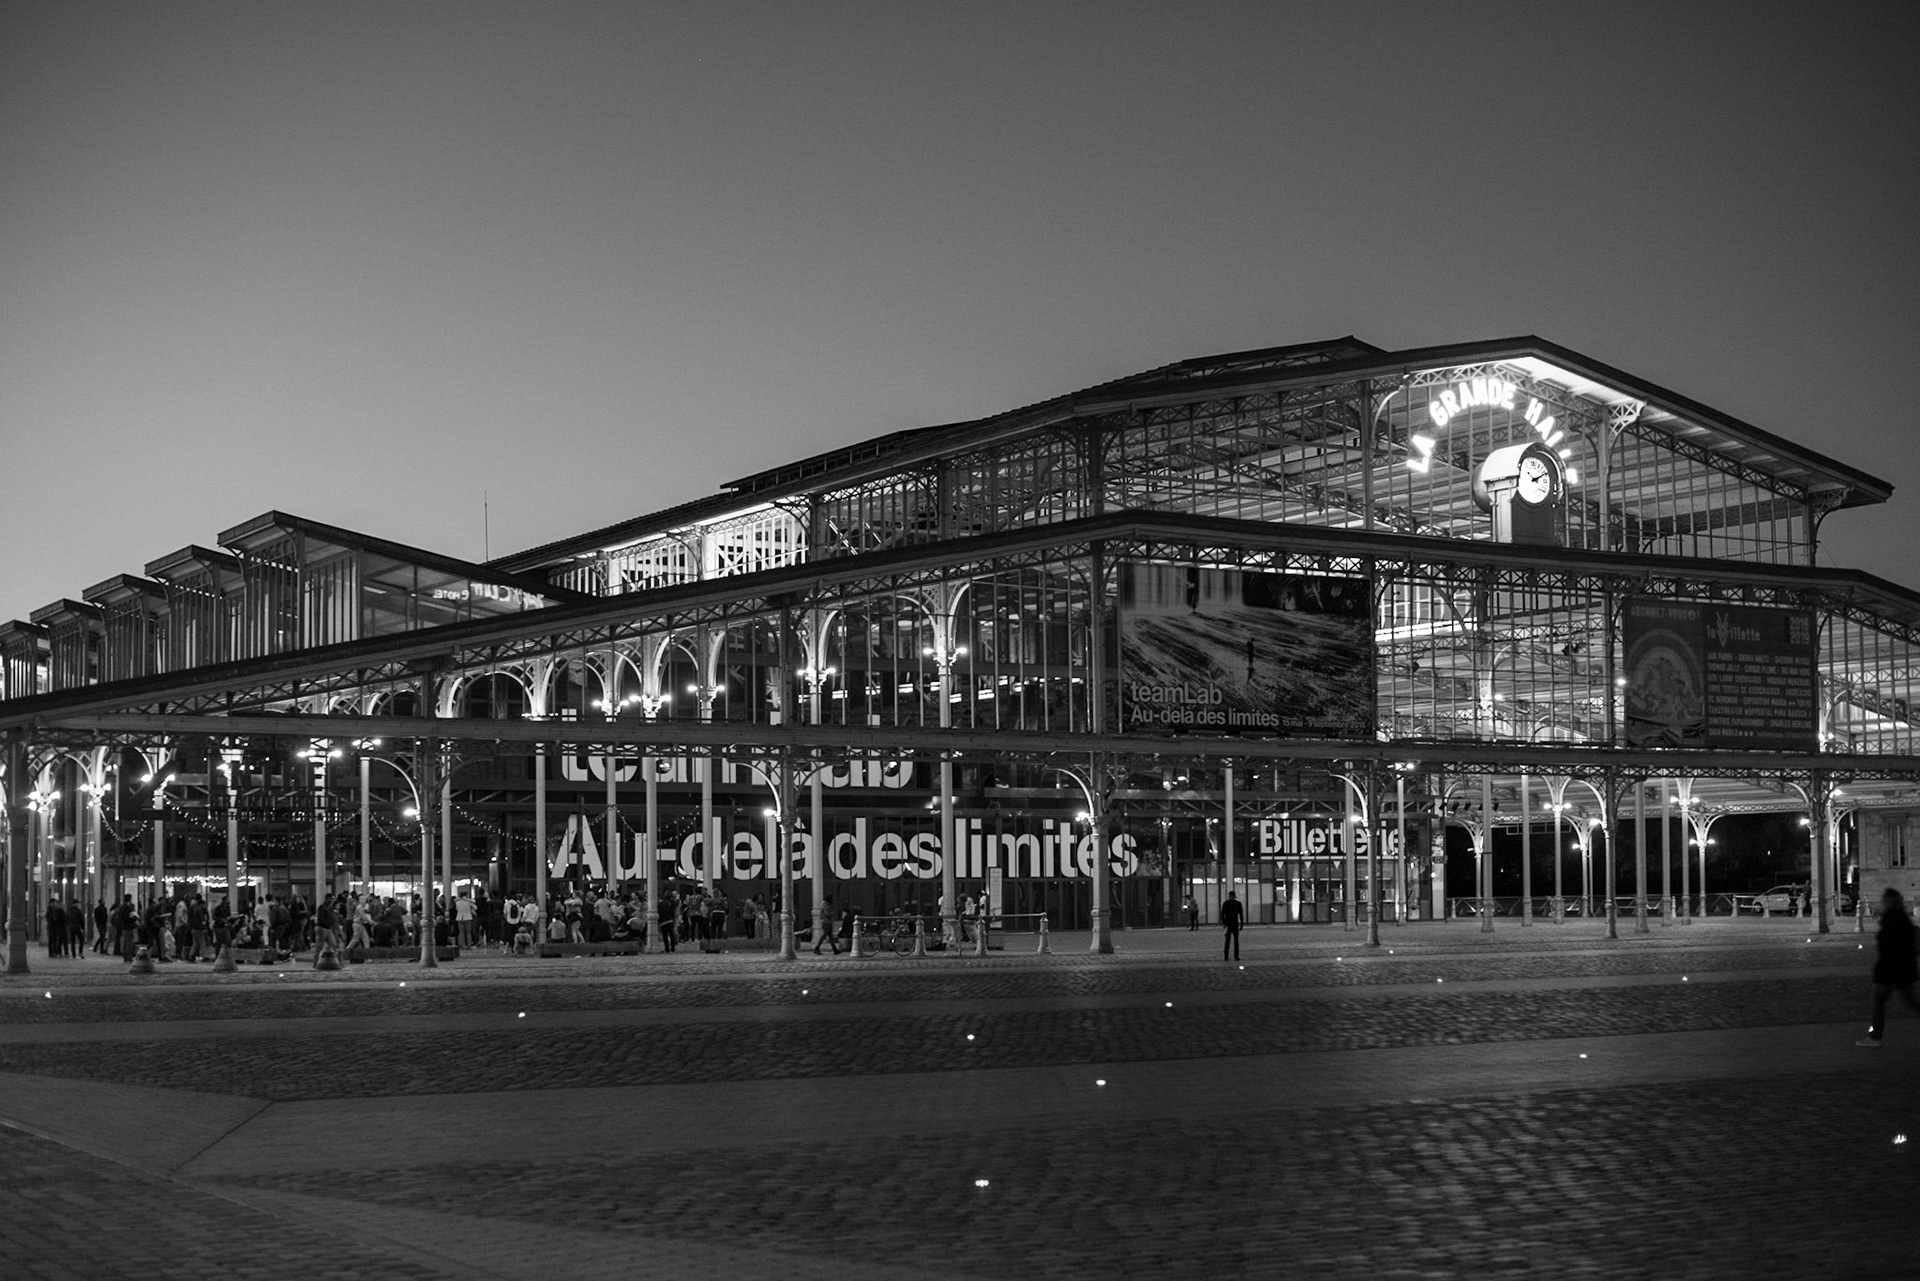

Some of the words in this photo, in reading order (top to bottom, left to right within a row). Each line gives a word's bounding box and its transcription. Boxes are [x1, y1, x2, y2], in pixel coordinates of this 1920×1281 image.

[1406, 434, 1437, 474] LA
[1429, 378, 1517, 427] GRANDE
[1130, 681, 1223, 705] teamLab
[1130, 705, 1194, 725] Au-delà
[1197, 707, 1226, 725] des
[1228, 707, 1280, 727] limites
[1290, 719, 1304, 727] mai
[1313, 719, 1349, 730] septembre
[1350, 721, 1366, 729] 2018
[550, 814, 816, 881] Au-delà
[828, 817, 943, 880] des
[955, 818, 1139, 878] limites
